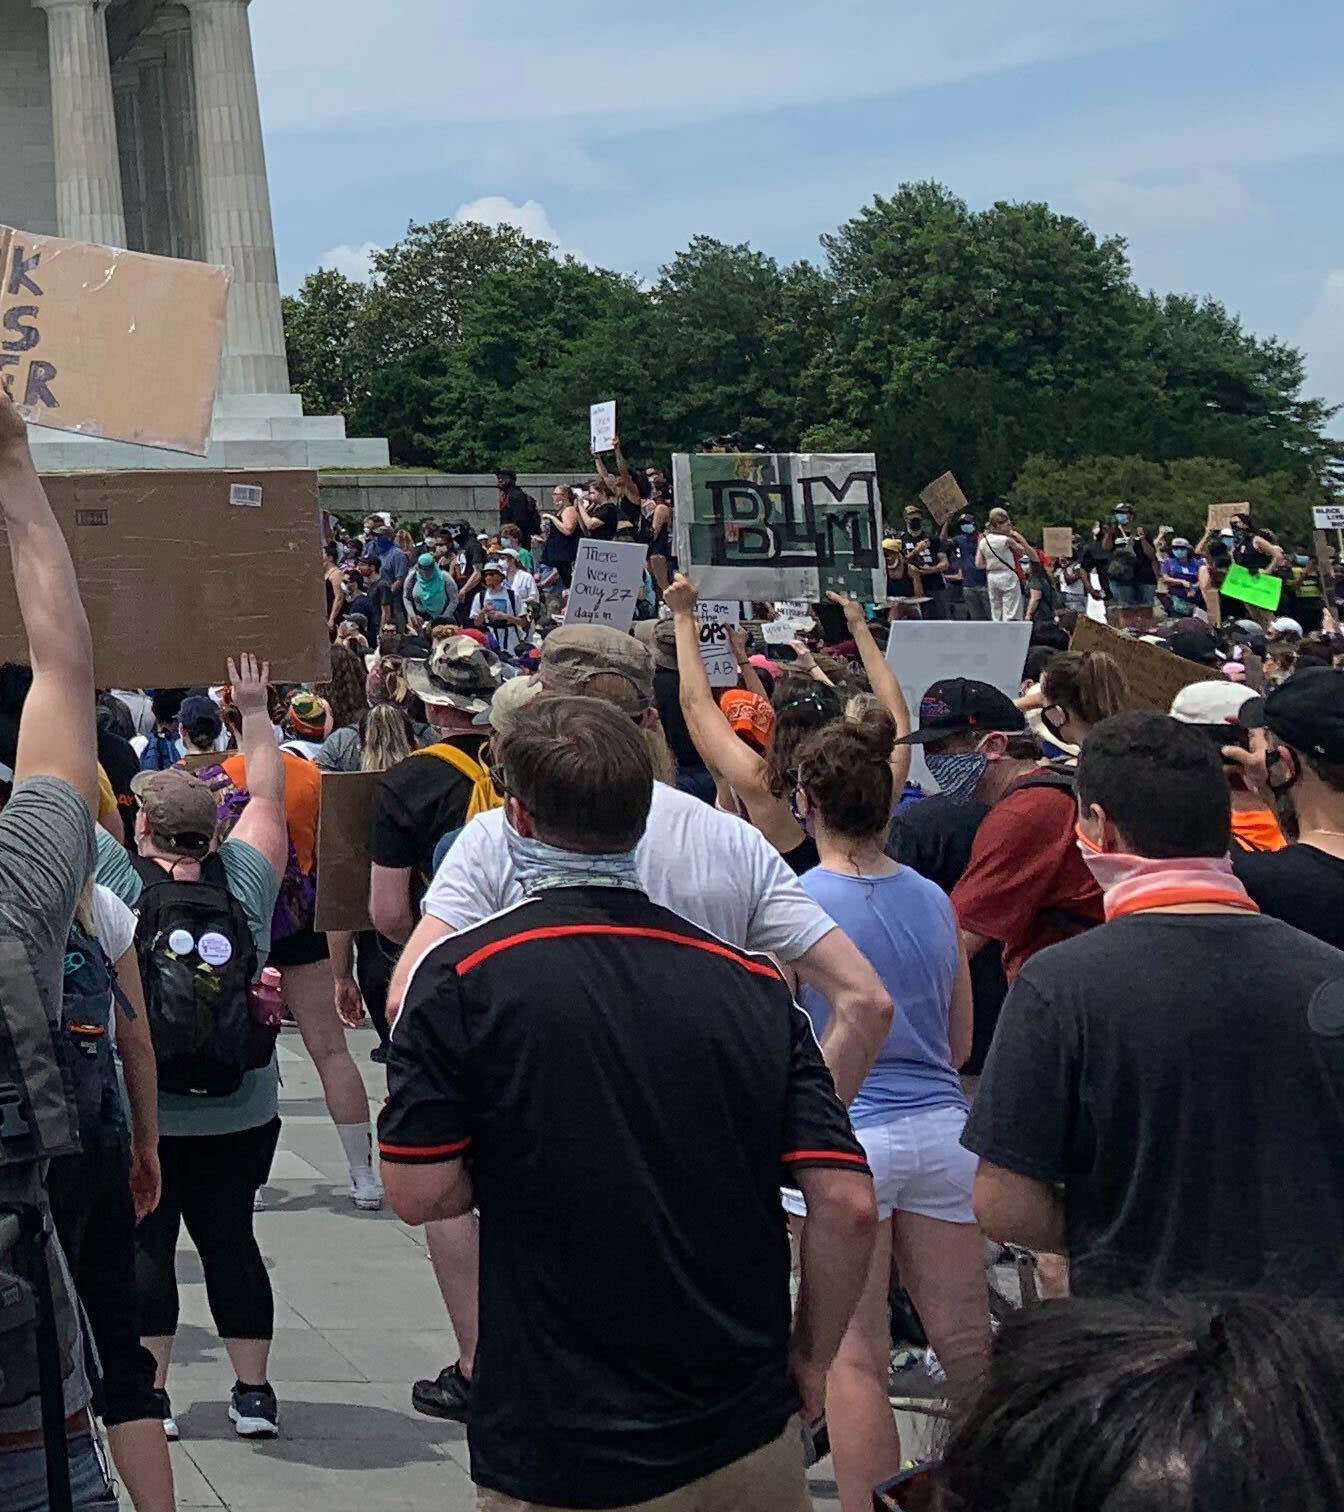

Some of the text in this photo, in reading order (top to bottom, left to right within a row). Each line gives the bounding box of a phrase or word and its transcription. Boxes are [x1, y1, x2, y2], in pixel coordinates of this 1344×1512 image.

[704, 470, 880, 569] BLM
[582, 545, 619, 564] There
[604, 588, 634, 603] 27
[574, 606, 600, 624] days
[699, 621, 736, 644] OPS
